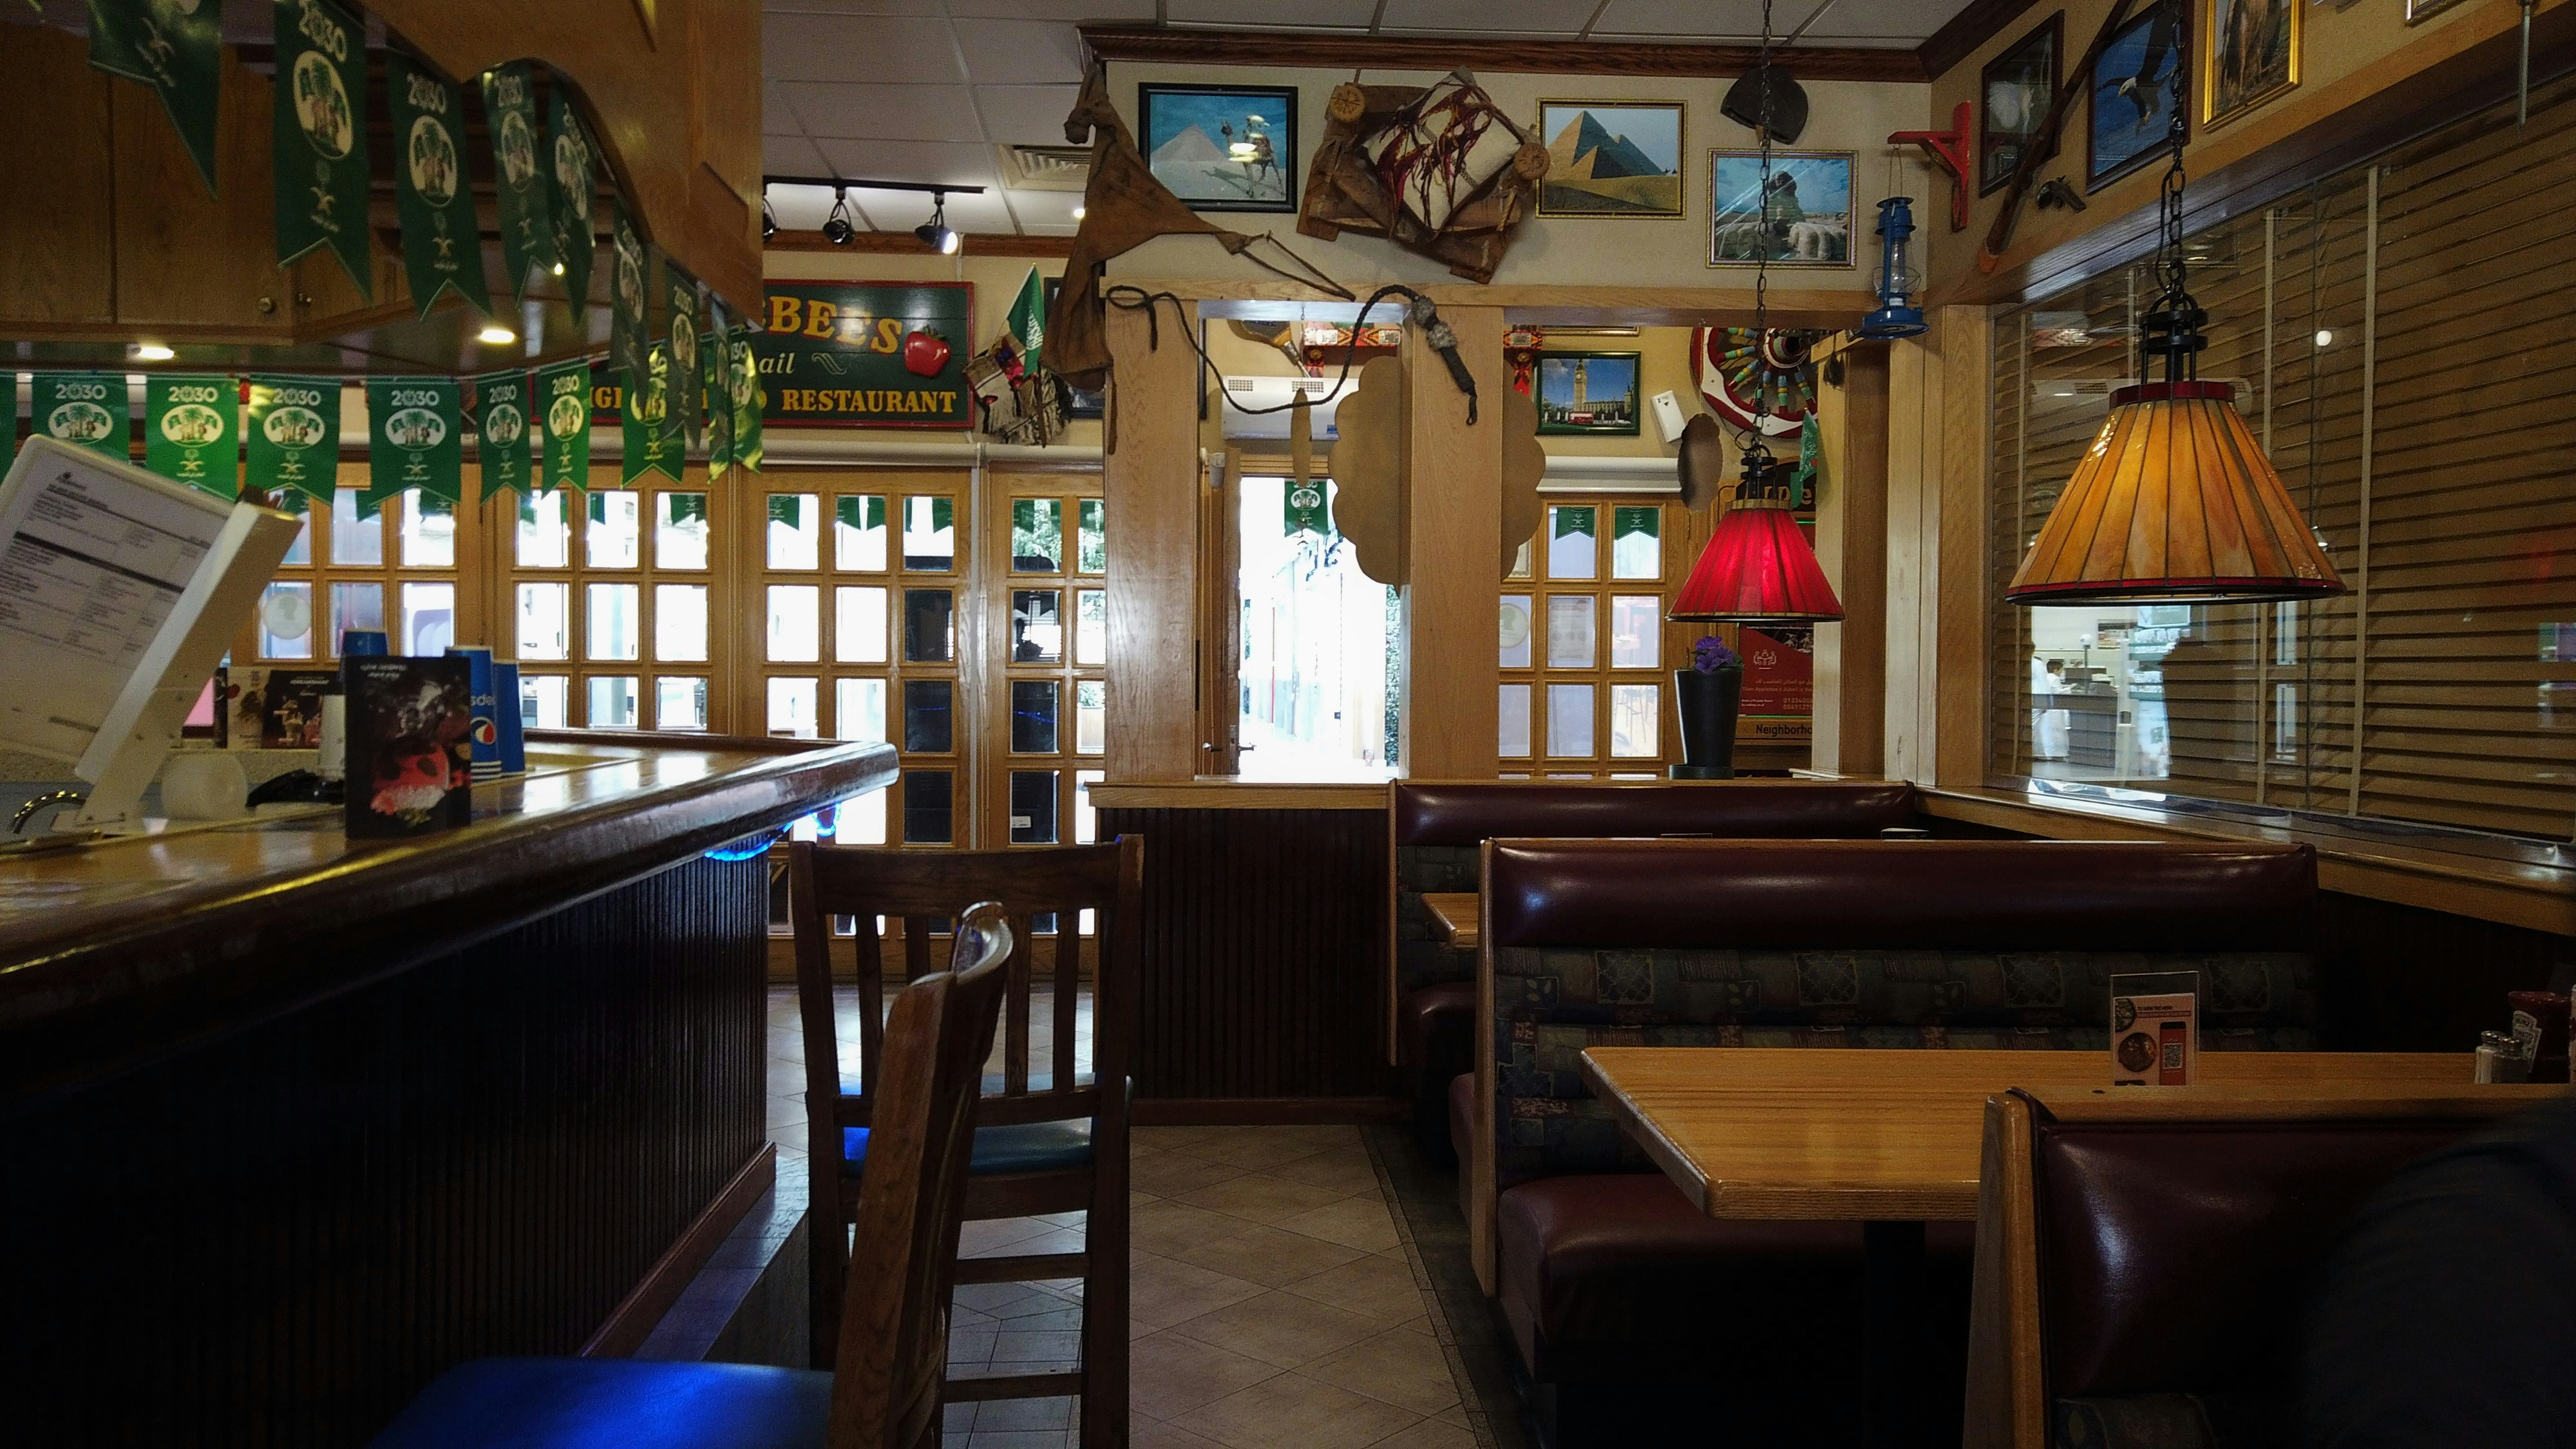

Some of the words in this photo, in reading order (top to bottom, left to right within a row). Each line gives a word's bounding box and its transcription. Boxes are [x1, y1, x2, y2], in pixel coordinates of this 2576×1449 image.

[762, 296, 903, 356] BEES
[759, 352, 796, 374] ail
[55, 383, 108, 400] 2030
[168, 385, 219, 402] 2030
[273, 387, 321, 406] 2030
[391, 389, 439, 406] 2030
[781, 388, 957, 414] RESTAURANT
[1756, 724, 1813, 737] Neighborho
